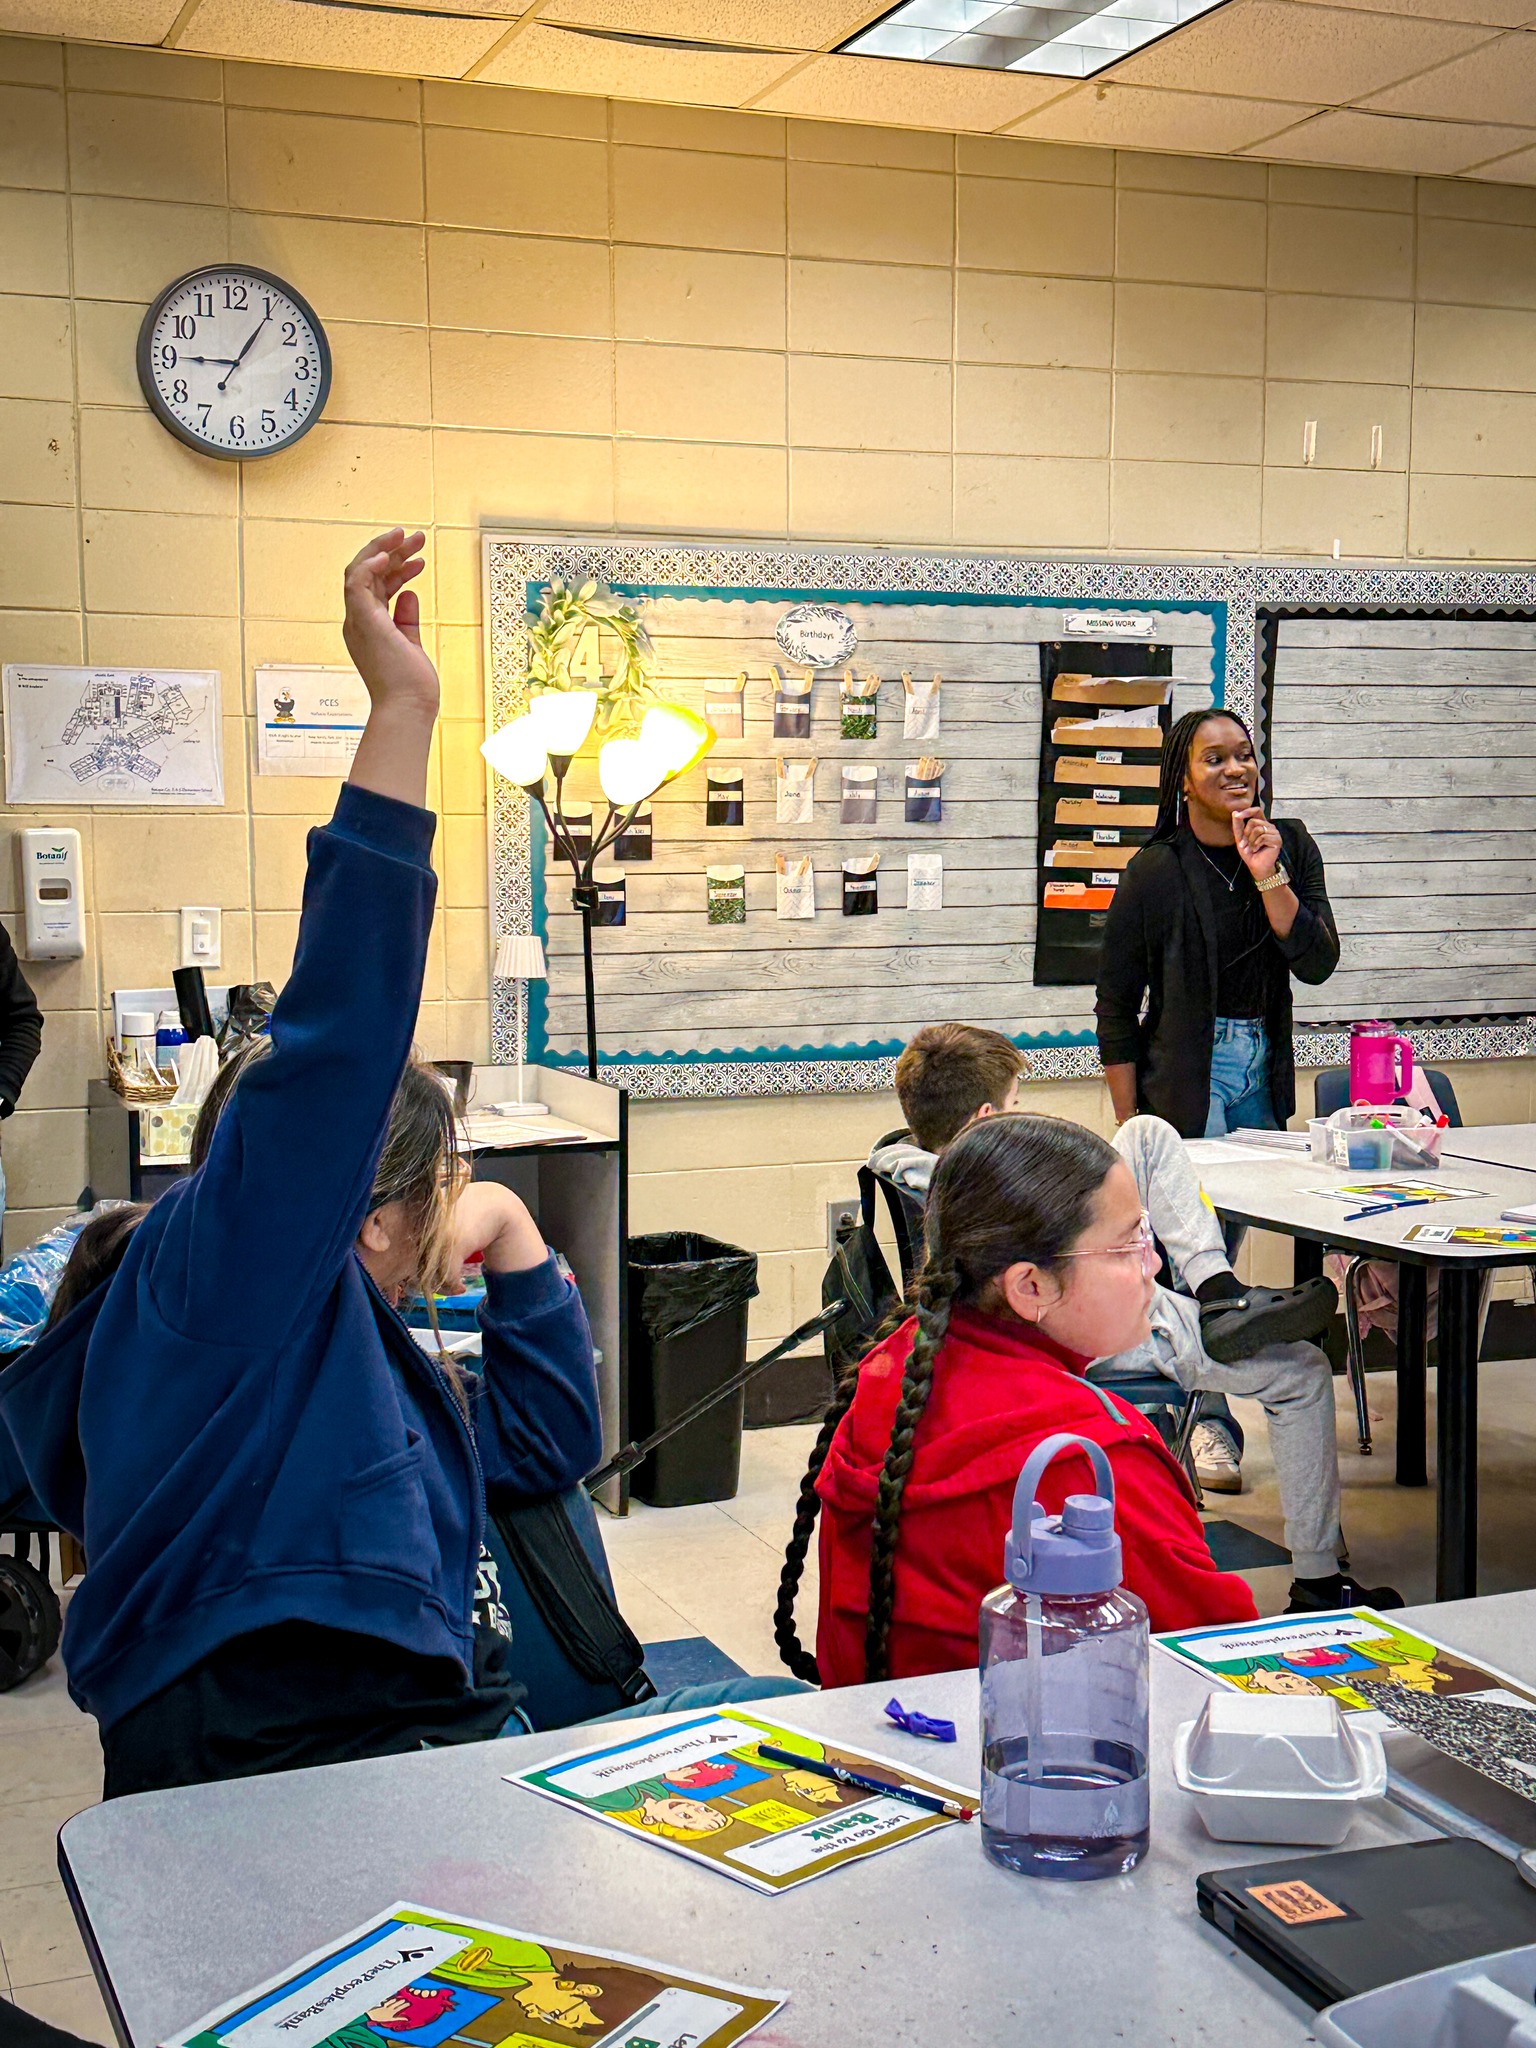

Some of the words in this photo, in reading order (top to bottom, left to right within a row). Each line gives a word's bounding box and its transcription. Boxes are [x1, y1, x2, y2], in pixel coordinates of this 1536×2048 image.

[193, 293, 215, 318] 11
[222, 285, 249, 311] 12
[262, 296, 273, 321] 1
[172, 315, 197, 340] 10
[281, 322, 298, 347] 2
[161, 344, 178, 369] 9
[294, 356, 310, 381] 3
[173, 379, 188, 404] 8
[283, 388, 299, 412] 4
[197, 403, 212, 428] 7
[229, 415, 245, 440] 6
[261, 409, 276, 434] 5
[799, 629, 835, 641] Birthdays
[1086, 619, 1113, 627] MISSING
[1115, 620, 1137, 628] WORK
[569, 625, 604, 687] 4
[1096, 832, 1116, 841] Thursday
[1095, 874, 1112, 883] Friday
[801, 1811, 880, 1842] Bank
[854, 1827, 876, 1840] Go
[874, 1814, 911, 1832] Let's
[810, 1841, 838, 1855] the
[836, 1835, 856, 1845] to
[279, 1958, 401, 2033] ThePeoplesBank
